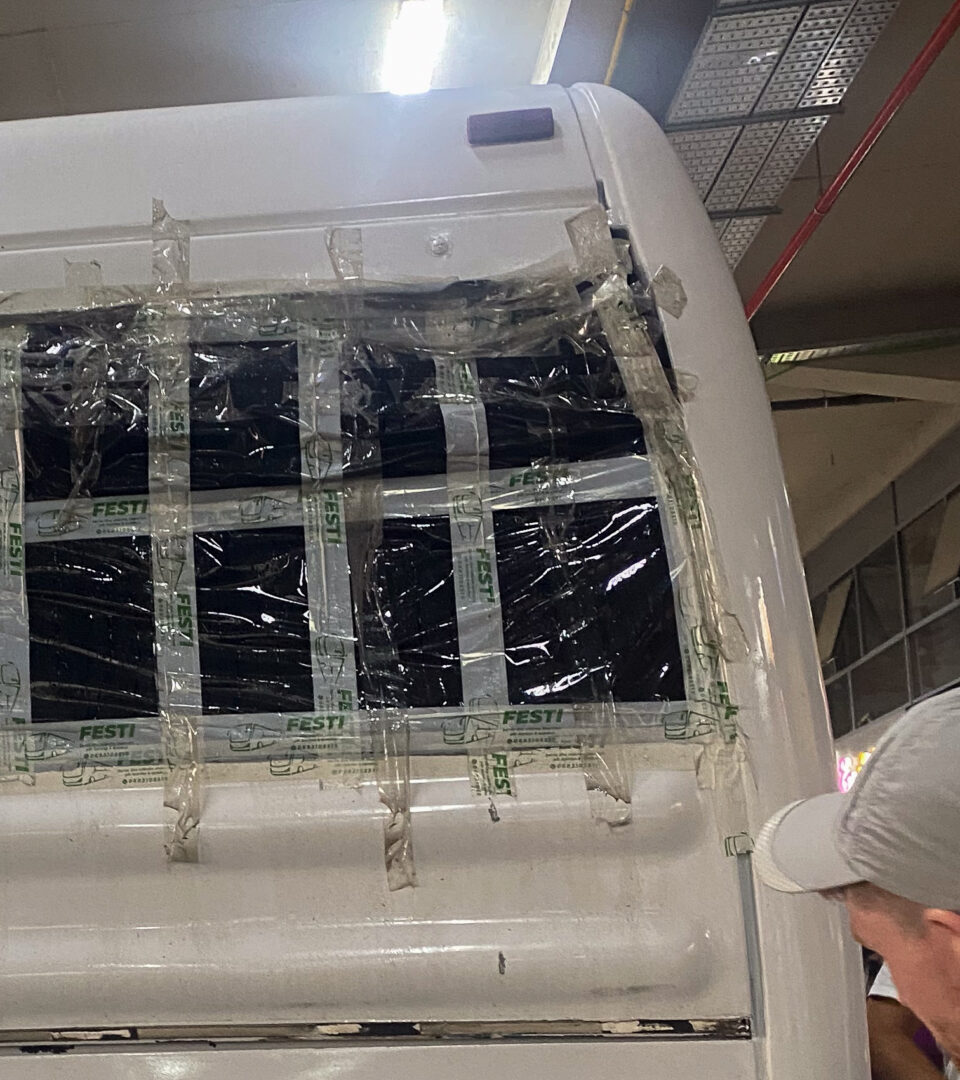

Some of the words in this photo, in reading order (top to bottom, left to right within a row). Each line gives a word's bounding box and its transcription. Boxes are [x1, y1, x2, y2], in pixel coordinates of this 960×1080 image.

[92, 501, 148, 516] FESTI
[324, 489, 342, 544] FESTI
[8, 522, 23, 577] FESTI
[476, 548, 495, 602] FESTI
[176, 593, 194, 647] FESTI
[79, 724, 135, 741] FESTI
[287, 715, 345, 732] FESTI
[503, 709, 564, 724] FESTI
[491, 753, 512, 795] FES
